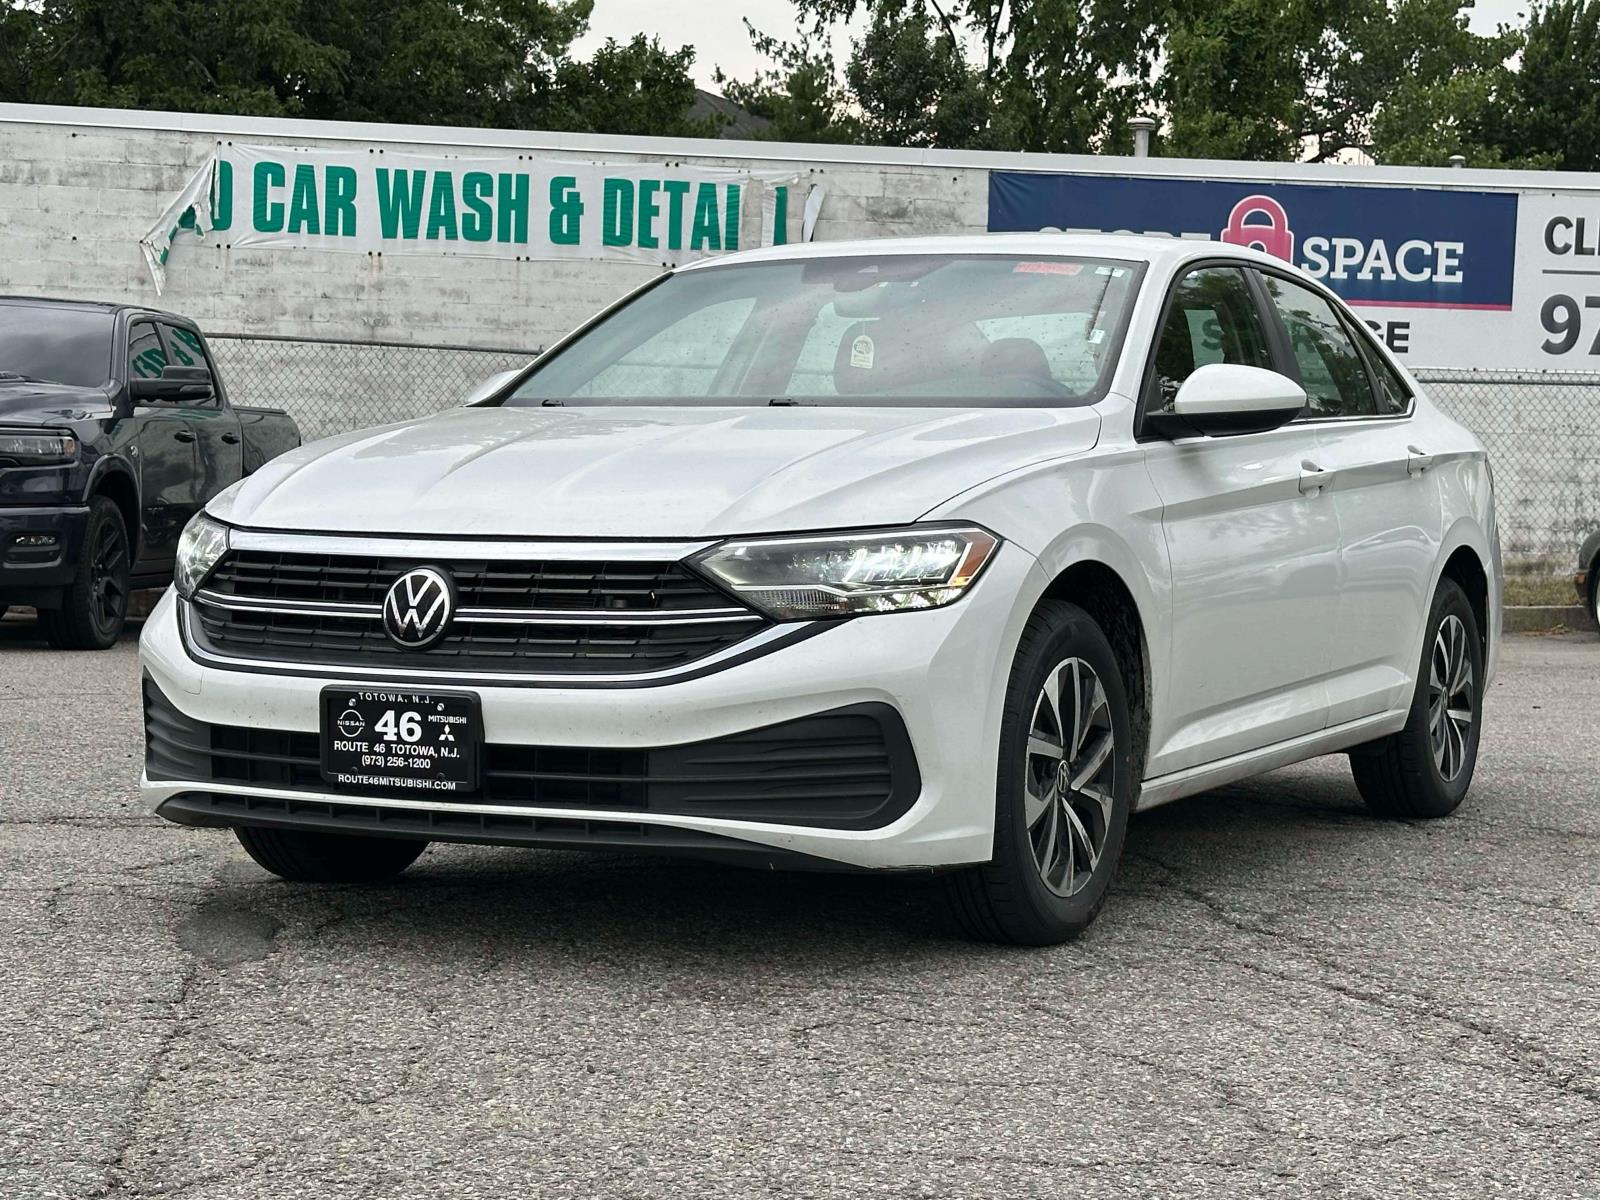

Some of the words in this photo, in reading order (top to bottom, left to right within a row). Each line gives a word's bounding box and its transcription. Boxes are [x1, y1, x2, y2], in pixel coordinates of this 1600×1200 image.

[252, 161, 358, 237] CAR
[376, 167, 530, 245] WASH
[549, 175, 585, 246] &
[1300, 236, 1465, 284] SPACE
[374, 709, 422, 742] 46
[428, 715, 467, 724] MITSUBISHI
[334, 740, 369, 752] ROUTE
[373, 743, 386, 753] 46
[391, 744, 438, 758] TOTOWA,
[440, 747, 460, 758] N.J.
[361, 754, 385, 767] (973)
[387, 757, 431, 769] 256-1200
[338, 774, 456, 791] ROUTE46MITSUBISHI.COM
